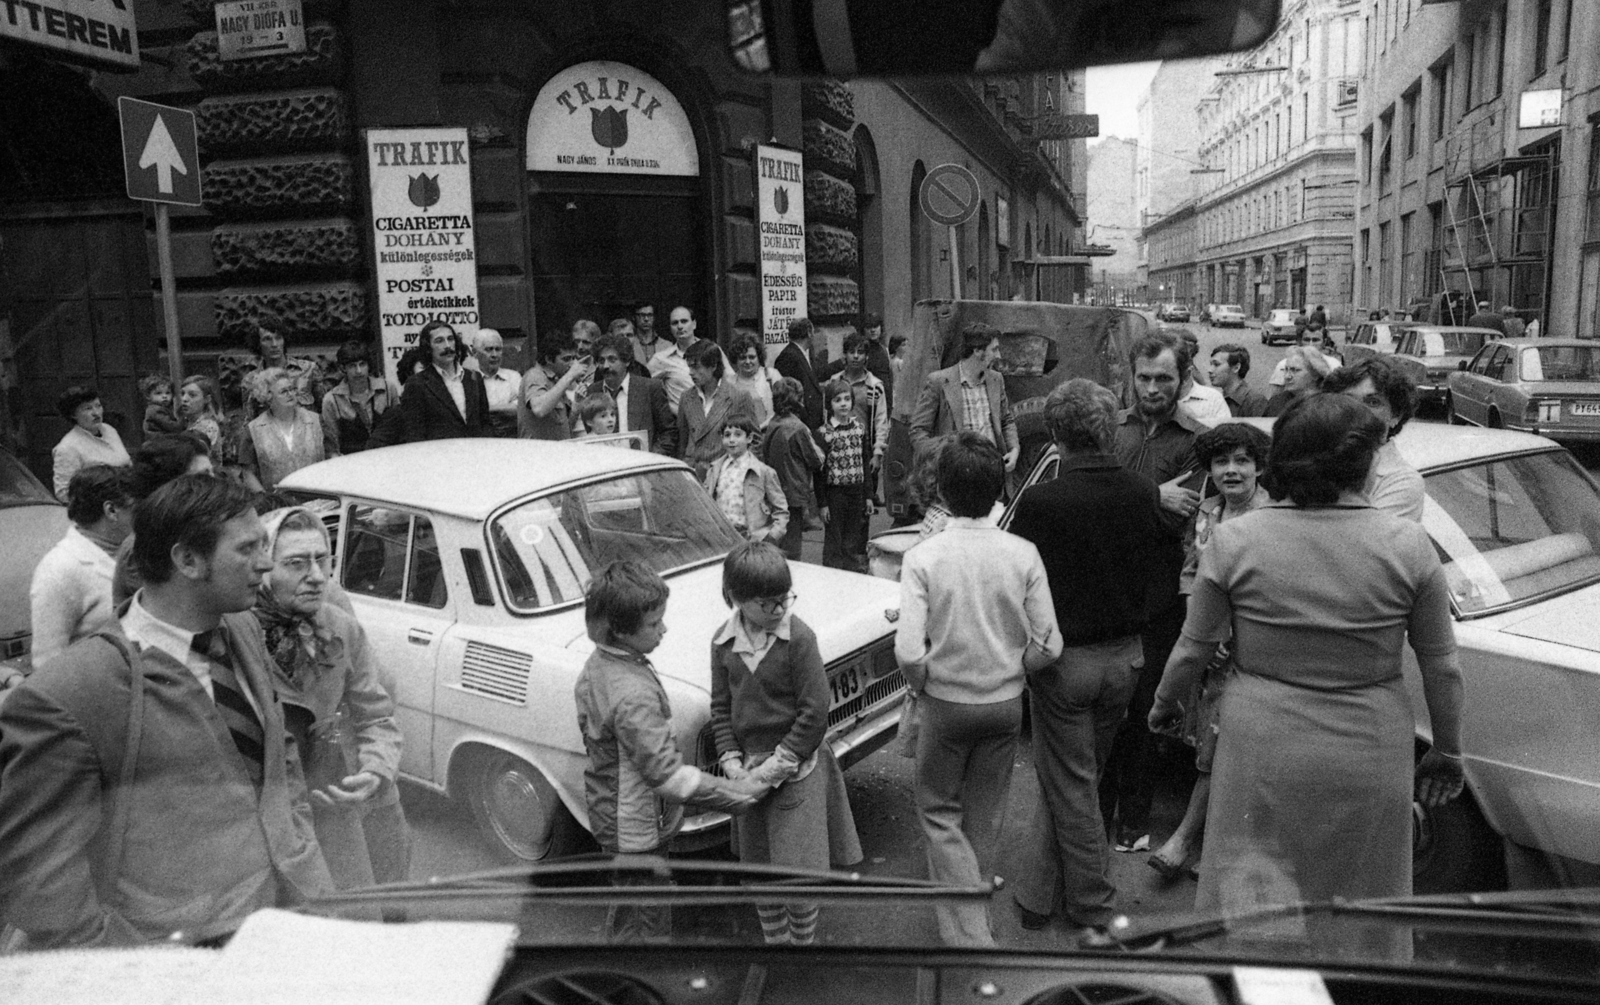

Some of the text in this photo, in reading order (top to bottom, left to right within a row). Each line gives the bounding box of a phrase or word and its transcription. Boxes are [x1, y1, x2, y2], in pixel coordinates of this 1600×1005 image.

[220, 15, 249, 34] NAGY
[253, 10, 286, 30] DIÓFA
[276, 31, 284, 41] 3
[556, 77, 662, 120] TRAFIK
[373, 141, 467, 166] TRAFIK
[556, 154, 575, 165] NAGY
[760, 156, 801, 183] TRAFIK
[375, 215, 471, 231] CIGARETTA
[761, 221, 803, 236] CIGARETTA
[385, 231, 465, 247] DOHÁNY
[380, 249, 474, 264] különlegességek
[386, 278, 454, 293] POSTAI
[763, 273, 803, 287] ÉDESSÉG
[407, 295, 475, 309] értékcikkek
[767, 316, 796, 330] JÁTÉ
